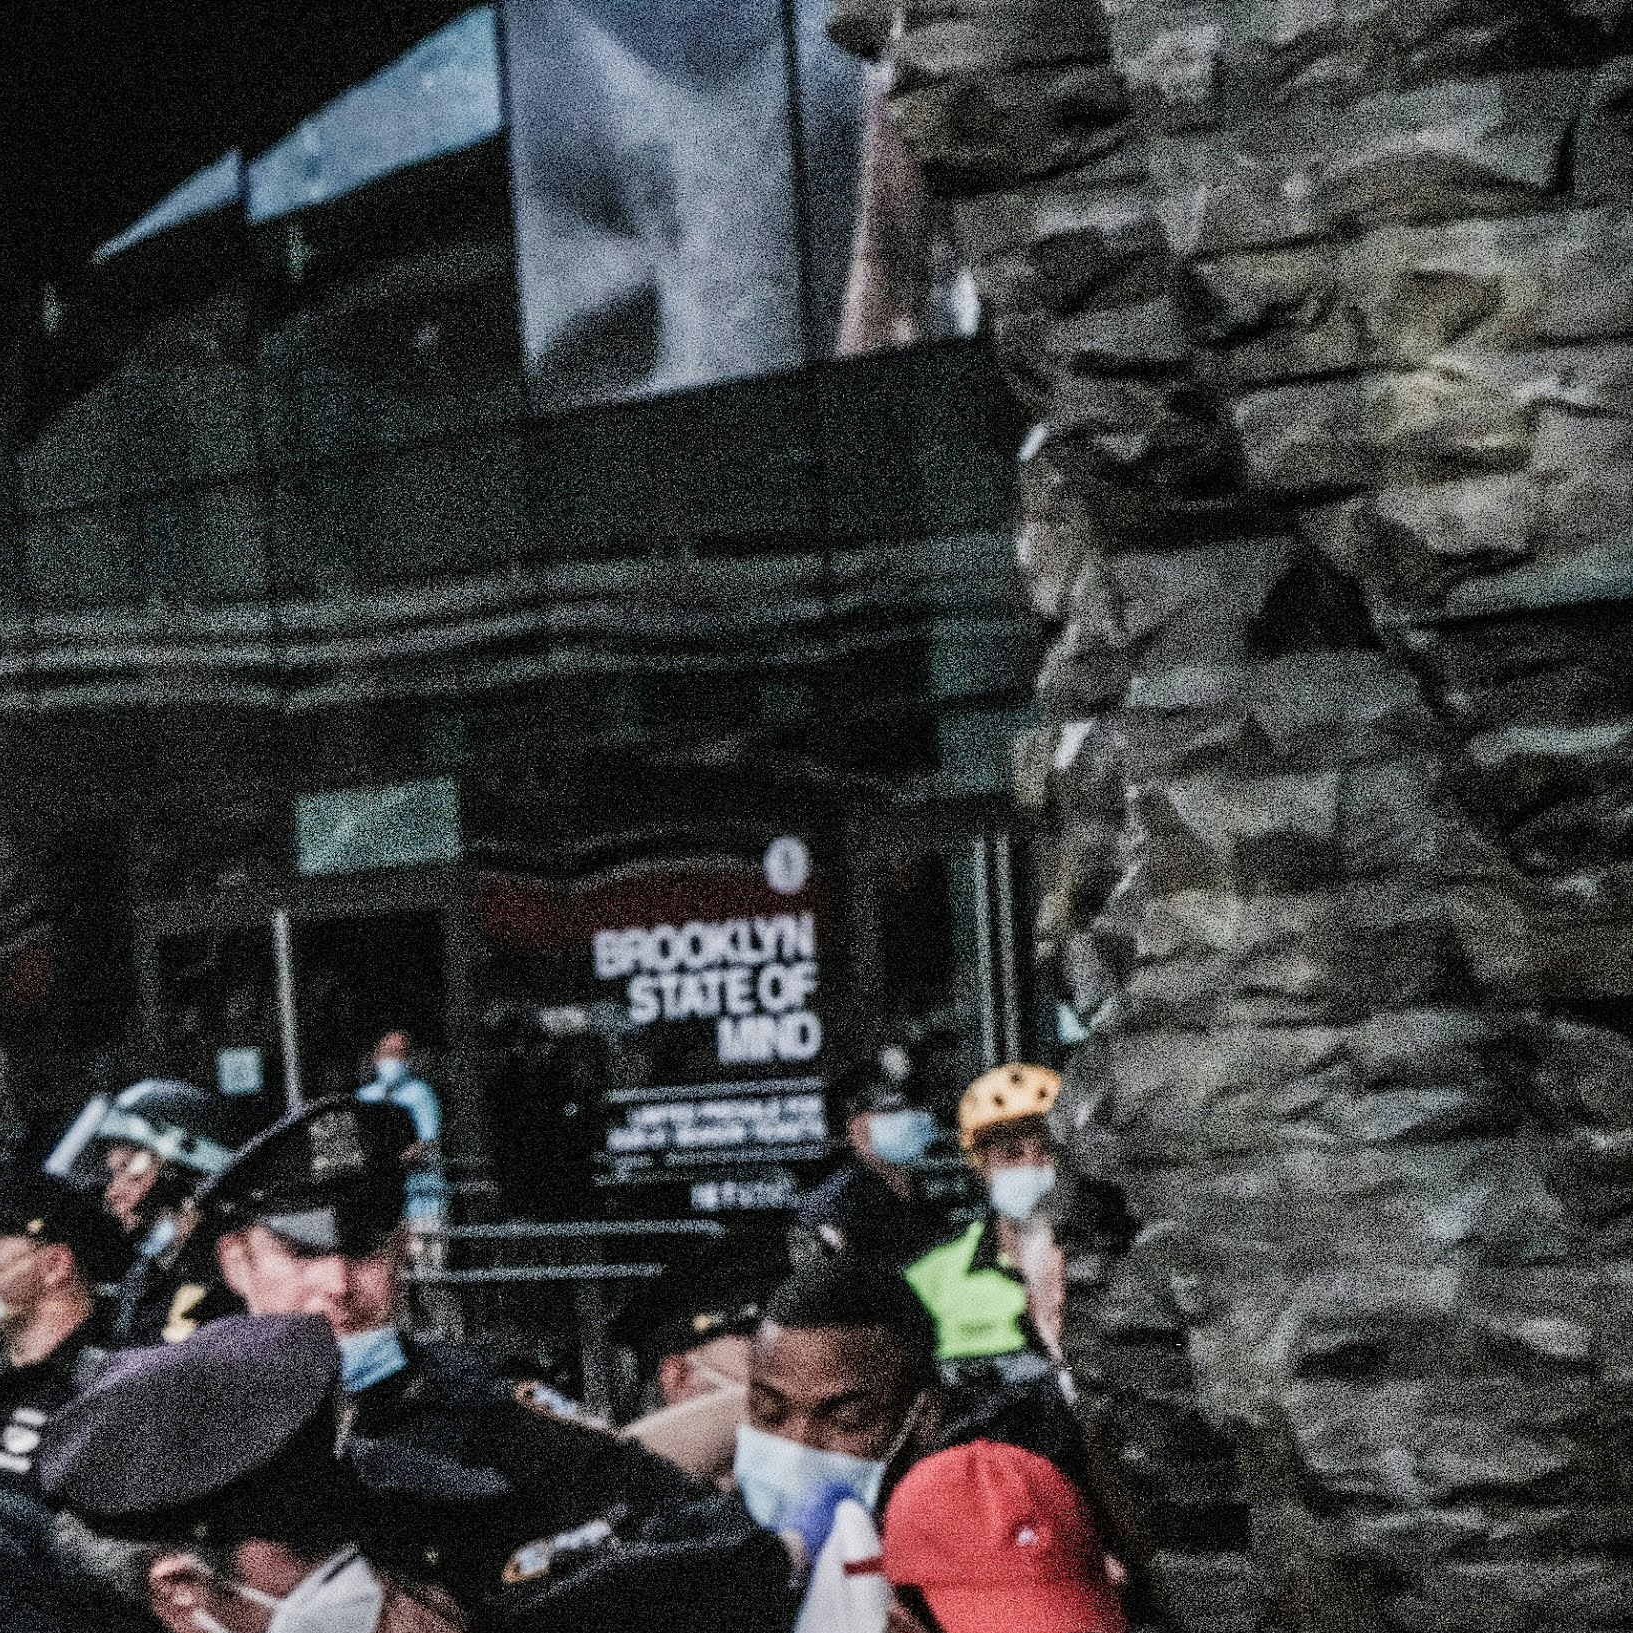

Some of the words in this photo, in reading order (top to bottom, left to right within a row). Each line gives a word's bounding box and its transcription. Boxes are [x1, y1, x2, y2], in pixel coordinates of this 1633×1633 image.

[593, 911, 815, 980] BROOKLYN
[629, 969, 755, 1025] STATE
[757, 962, 817, 1012] OF
